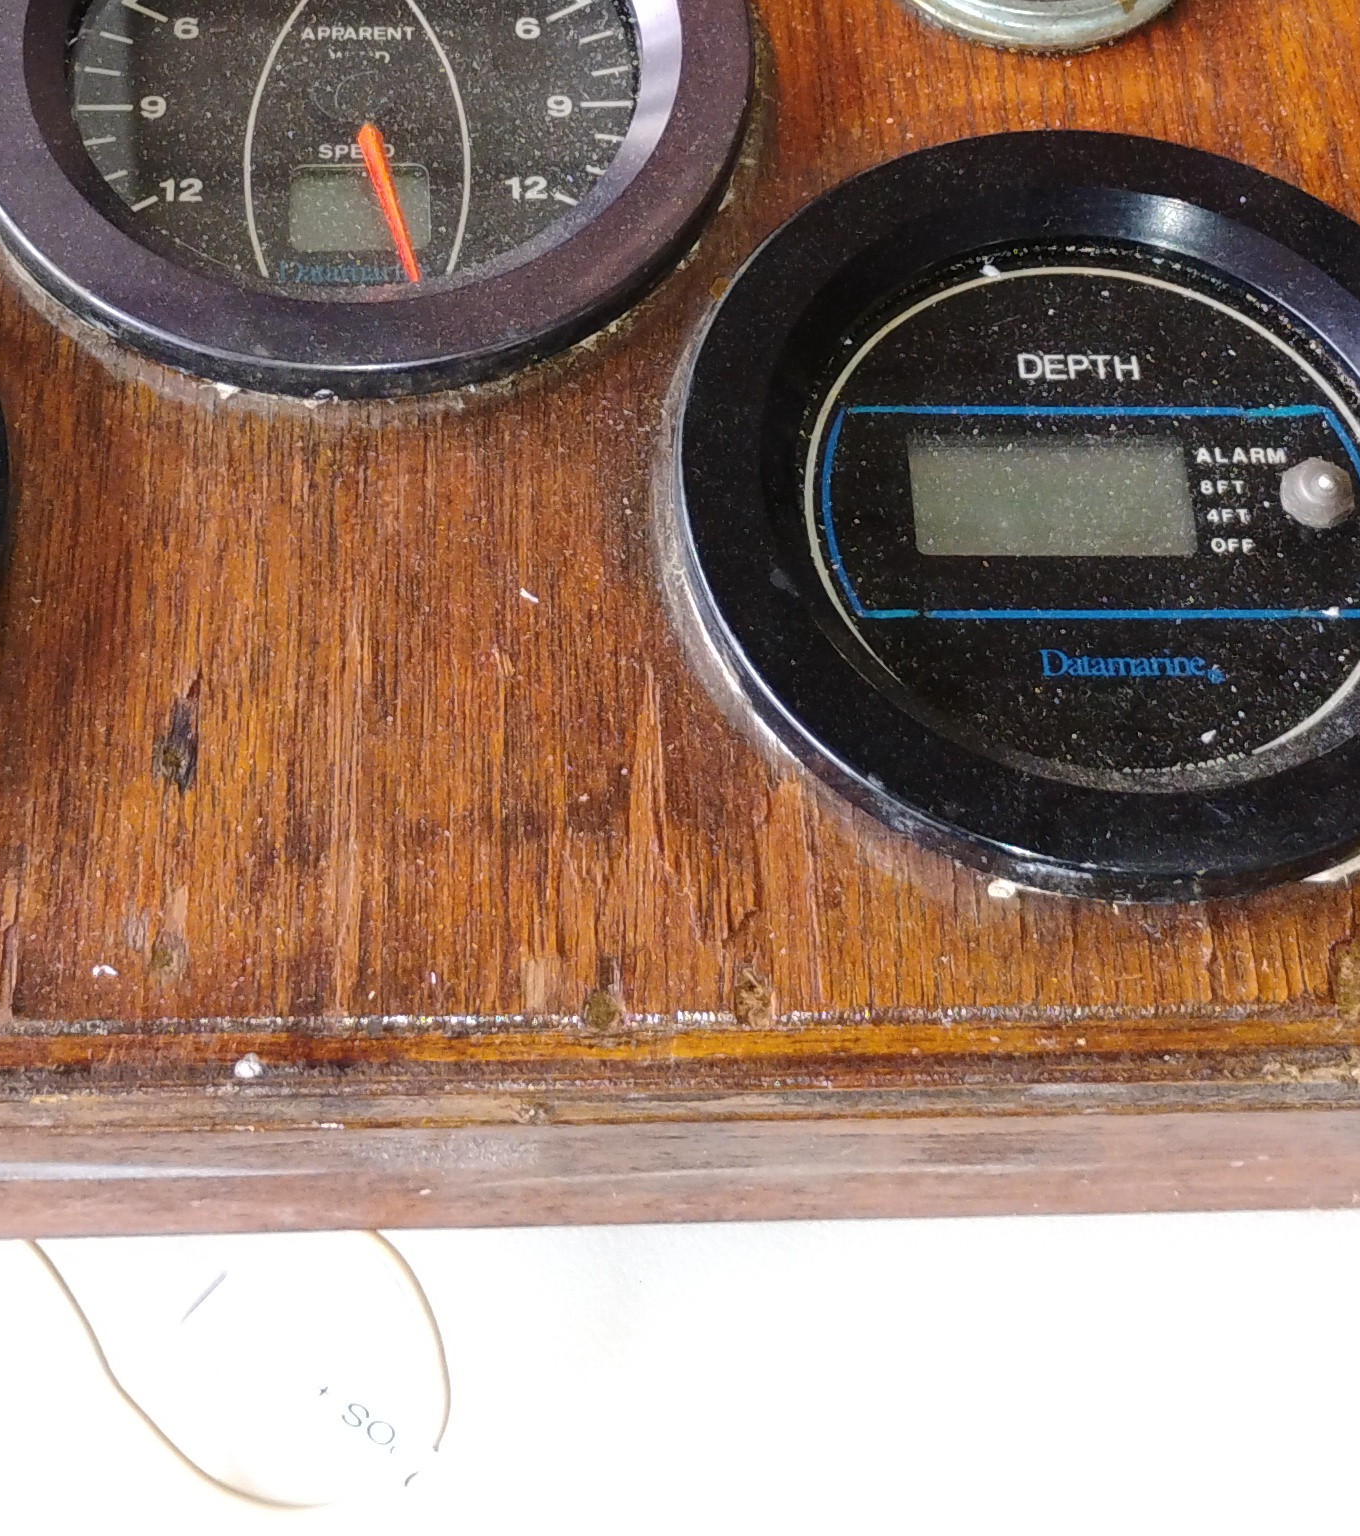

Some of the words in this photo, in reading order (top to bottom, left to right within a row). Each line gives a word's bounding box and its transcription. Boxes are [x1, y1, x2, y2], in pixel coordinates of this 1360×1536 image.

[172, 17, 200, 40] 6
[301, 25, 416, 41] APPARENT
[515, 17, 541, 41] 6
[140, 95, 168, 120] 9
[546, 94, 573, 119] 9
[318, 143, 396, 161] SPED
[159, 177, 203, 203] 12
[504, 175, 549, 202] 12
[1018, 353, 1140, 381] DEPTH
[1196, 447, 1288, 465] ALARM
[1210, 536, 1254, 554] OFF
[1040, 649, 1208, 679] Datamarine
